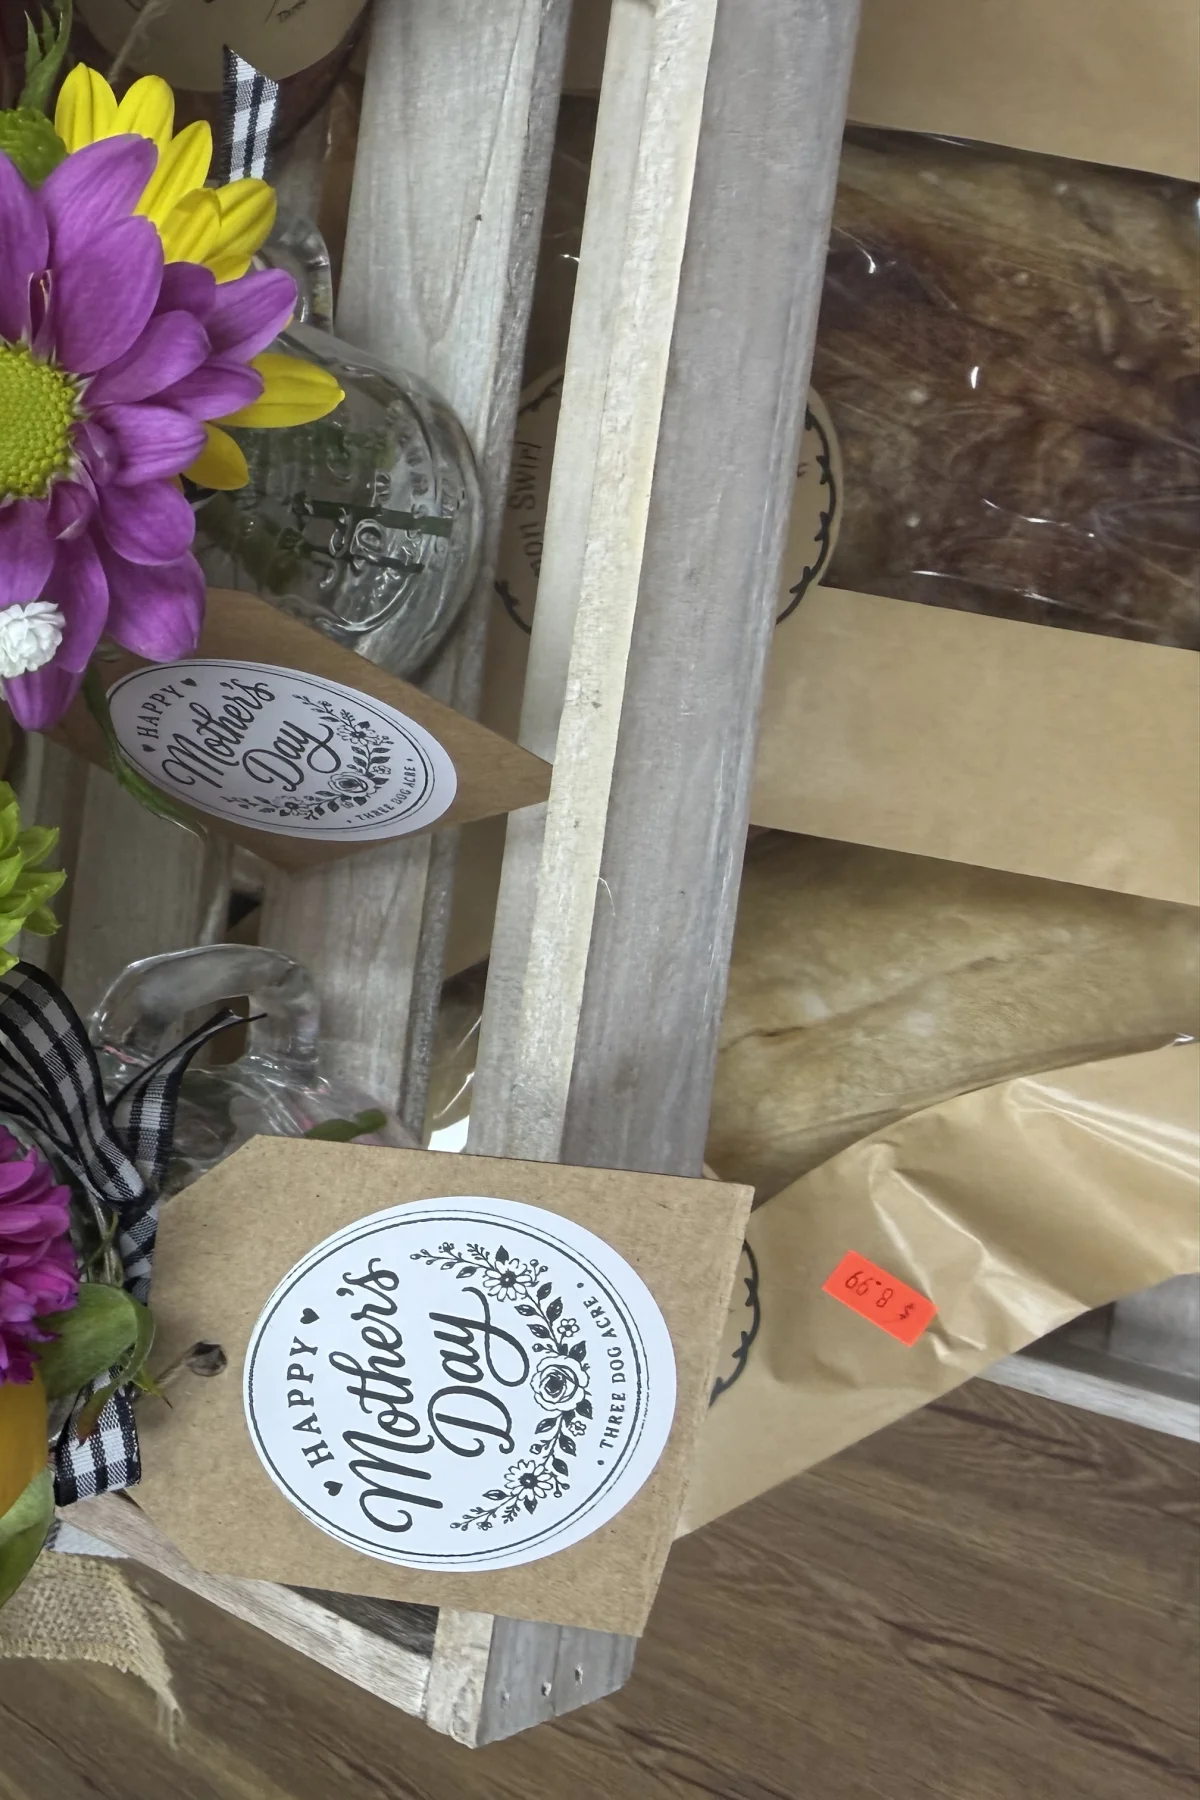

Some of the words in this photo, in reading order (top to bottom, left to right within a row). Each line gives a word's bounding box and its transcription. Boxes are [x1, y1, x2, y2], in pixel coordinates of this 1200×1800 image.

[138, 684, 185, 740] HAPPY
[161, 678, 276, 789] Mother's
[242, 720, 342, 792] Day
[355, 800, 396, 822] THREE
[394, 786, 411, 805] DOG
[406, 762, 417, 790] ACRE
[582, 1295, 617, 1339] ACRE
[844, 1270, 895, 1309] 8.99
[328, 1256, 444, 1533] Mother's
[427, 1286, 530, 1459] Day
[607, 1346, 627, 1384] DOG
[286, 1335, 336, 1469] HAPPY
[599, 1392, 627, 1450] THREE
